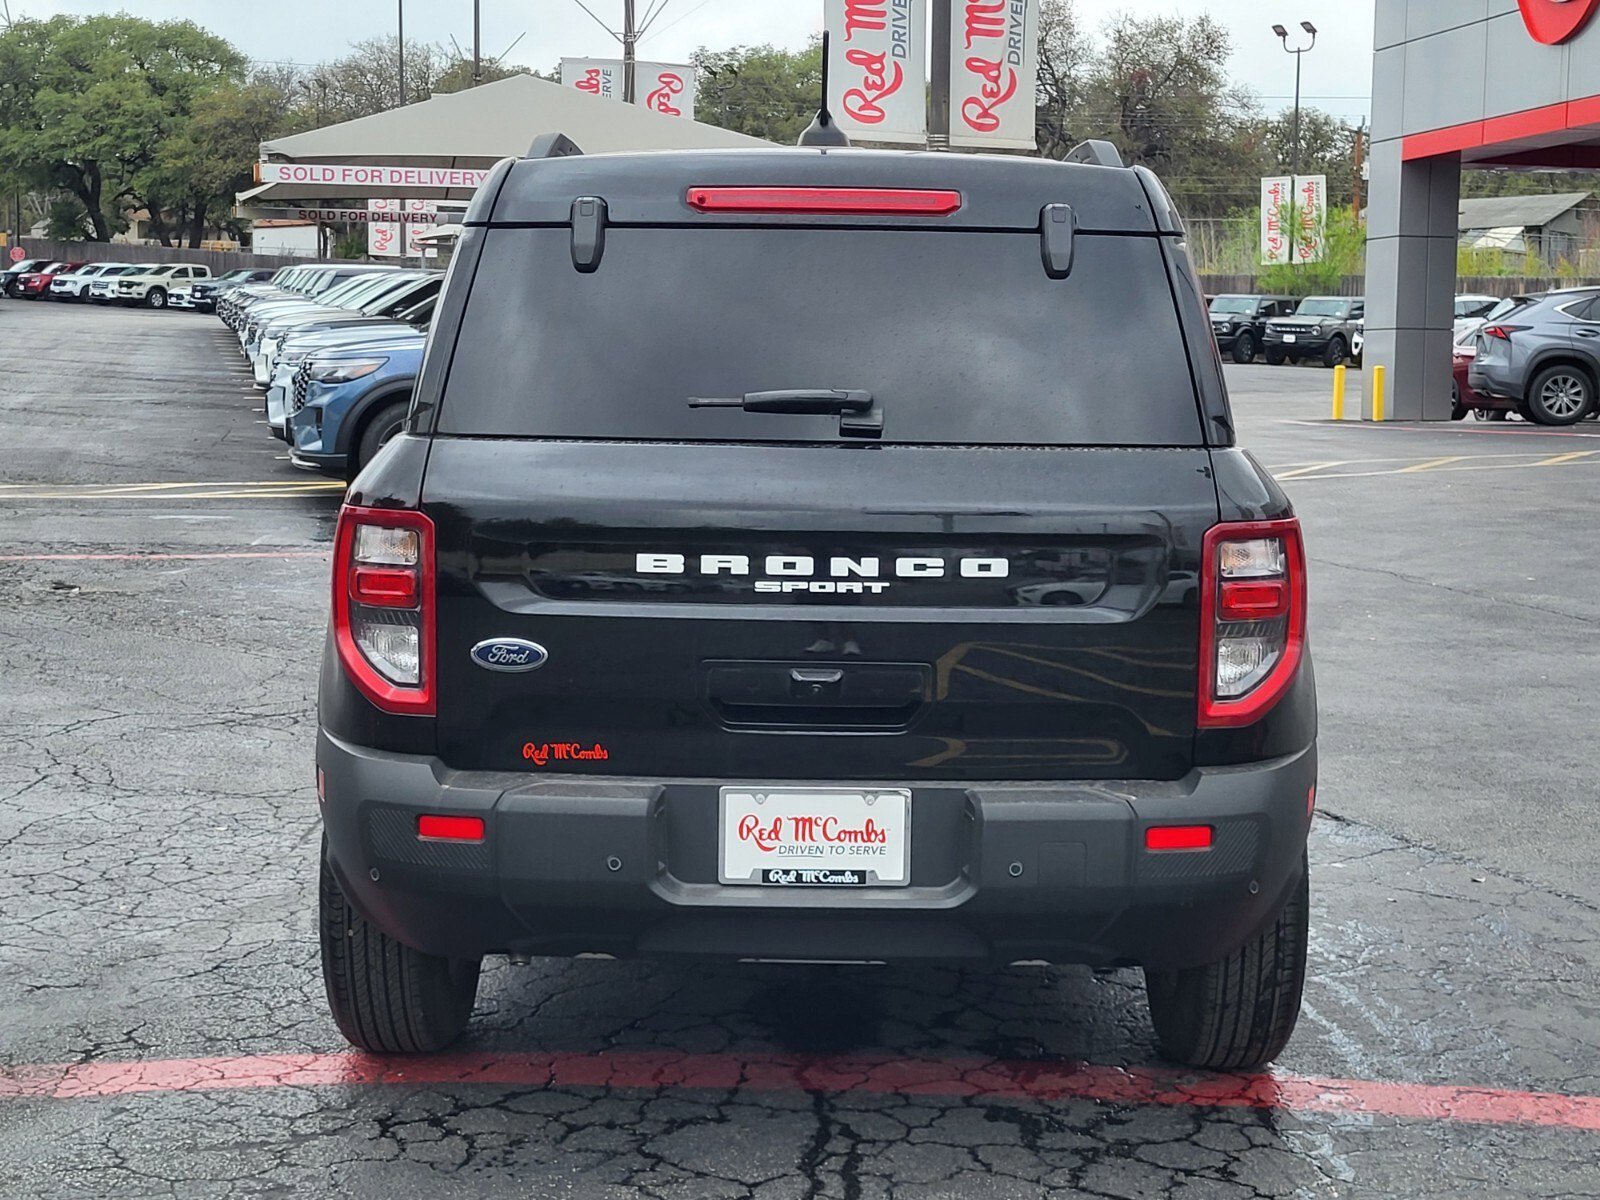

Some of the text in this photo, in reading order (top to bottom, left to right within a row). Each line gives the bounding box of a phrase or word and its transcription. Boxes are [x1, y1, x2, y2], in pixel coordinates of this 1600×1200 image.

[1007, 0, 1024, 66] DRIVE
[646, 72, 684, 117] Red
[843, 49, 903, 124] Red
[961, 57, 1017, 132] Red
[279, 166, 488, 186] SOLD FOR DELIVERY
[298, 209, 438, 223] SOLD FOR DELIVERY
[374, 228, 393, 251] Red
[635, 553, 1009, 578] BRONCO
[754, 581, 890, 593] SPORT
[487, 644, 530, 664] Ford
[522, 742, 608, 766] Red McCombs
[738, 814, 887, 853] Red McCombs
[778, 845, 887, 856] DRIVEN TO SERVE
[768, 869, 859, 885] Red McCombs
